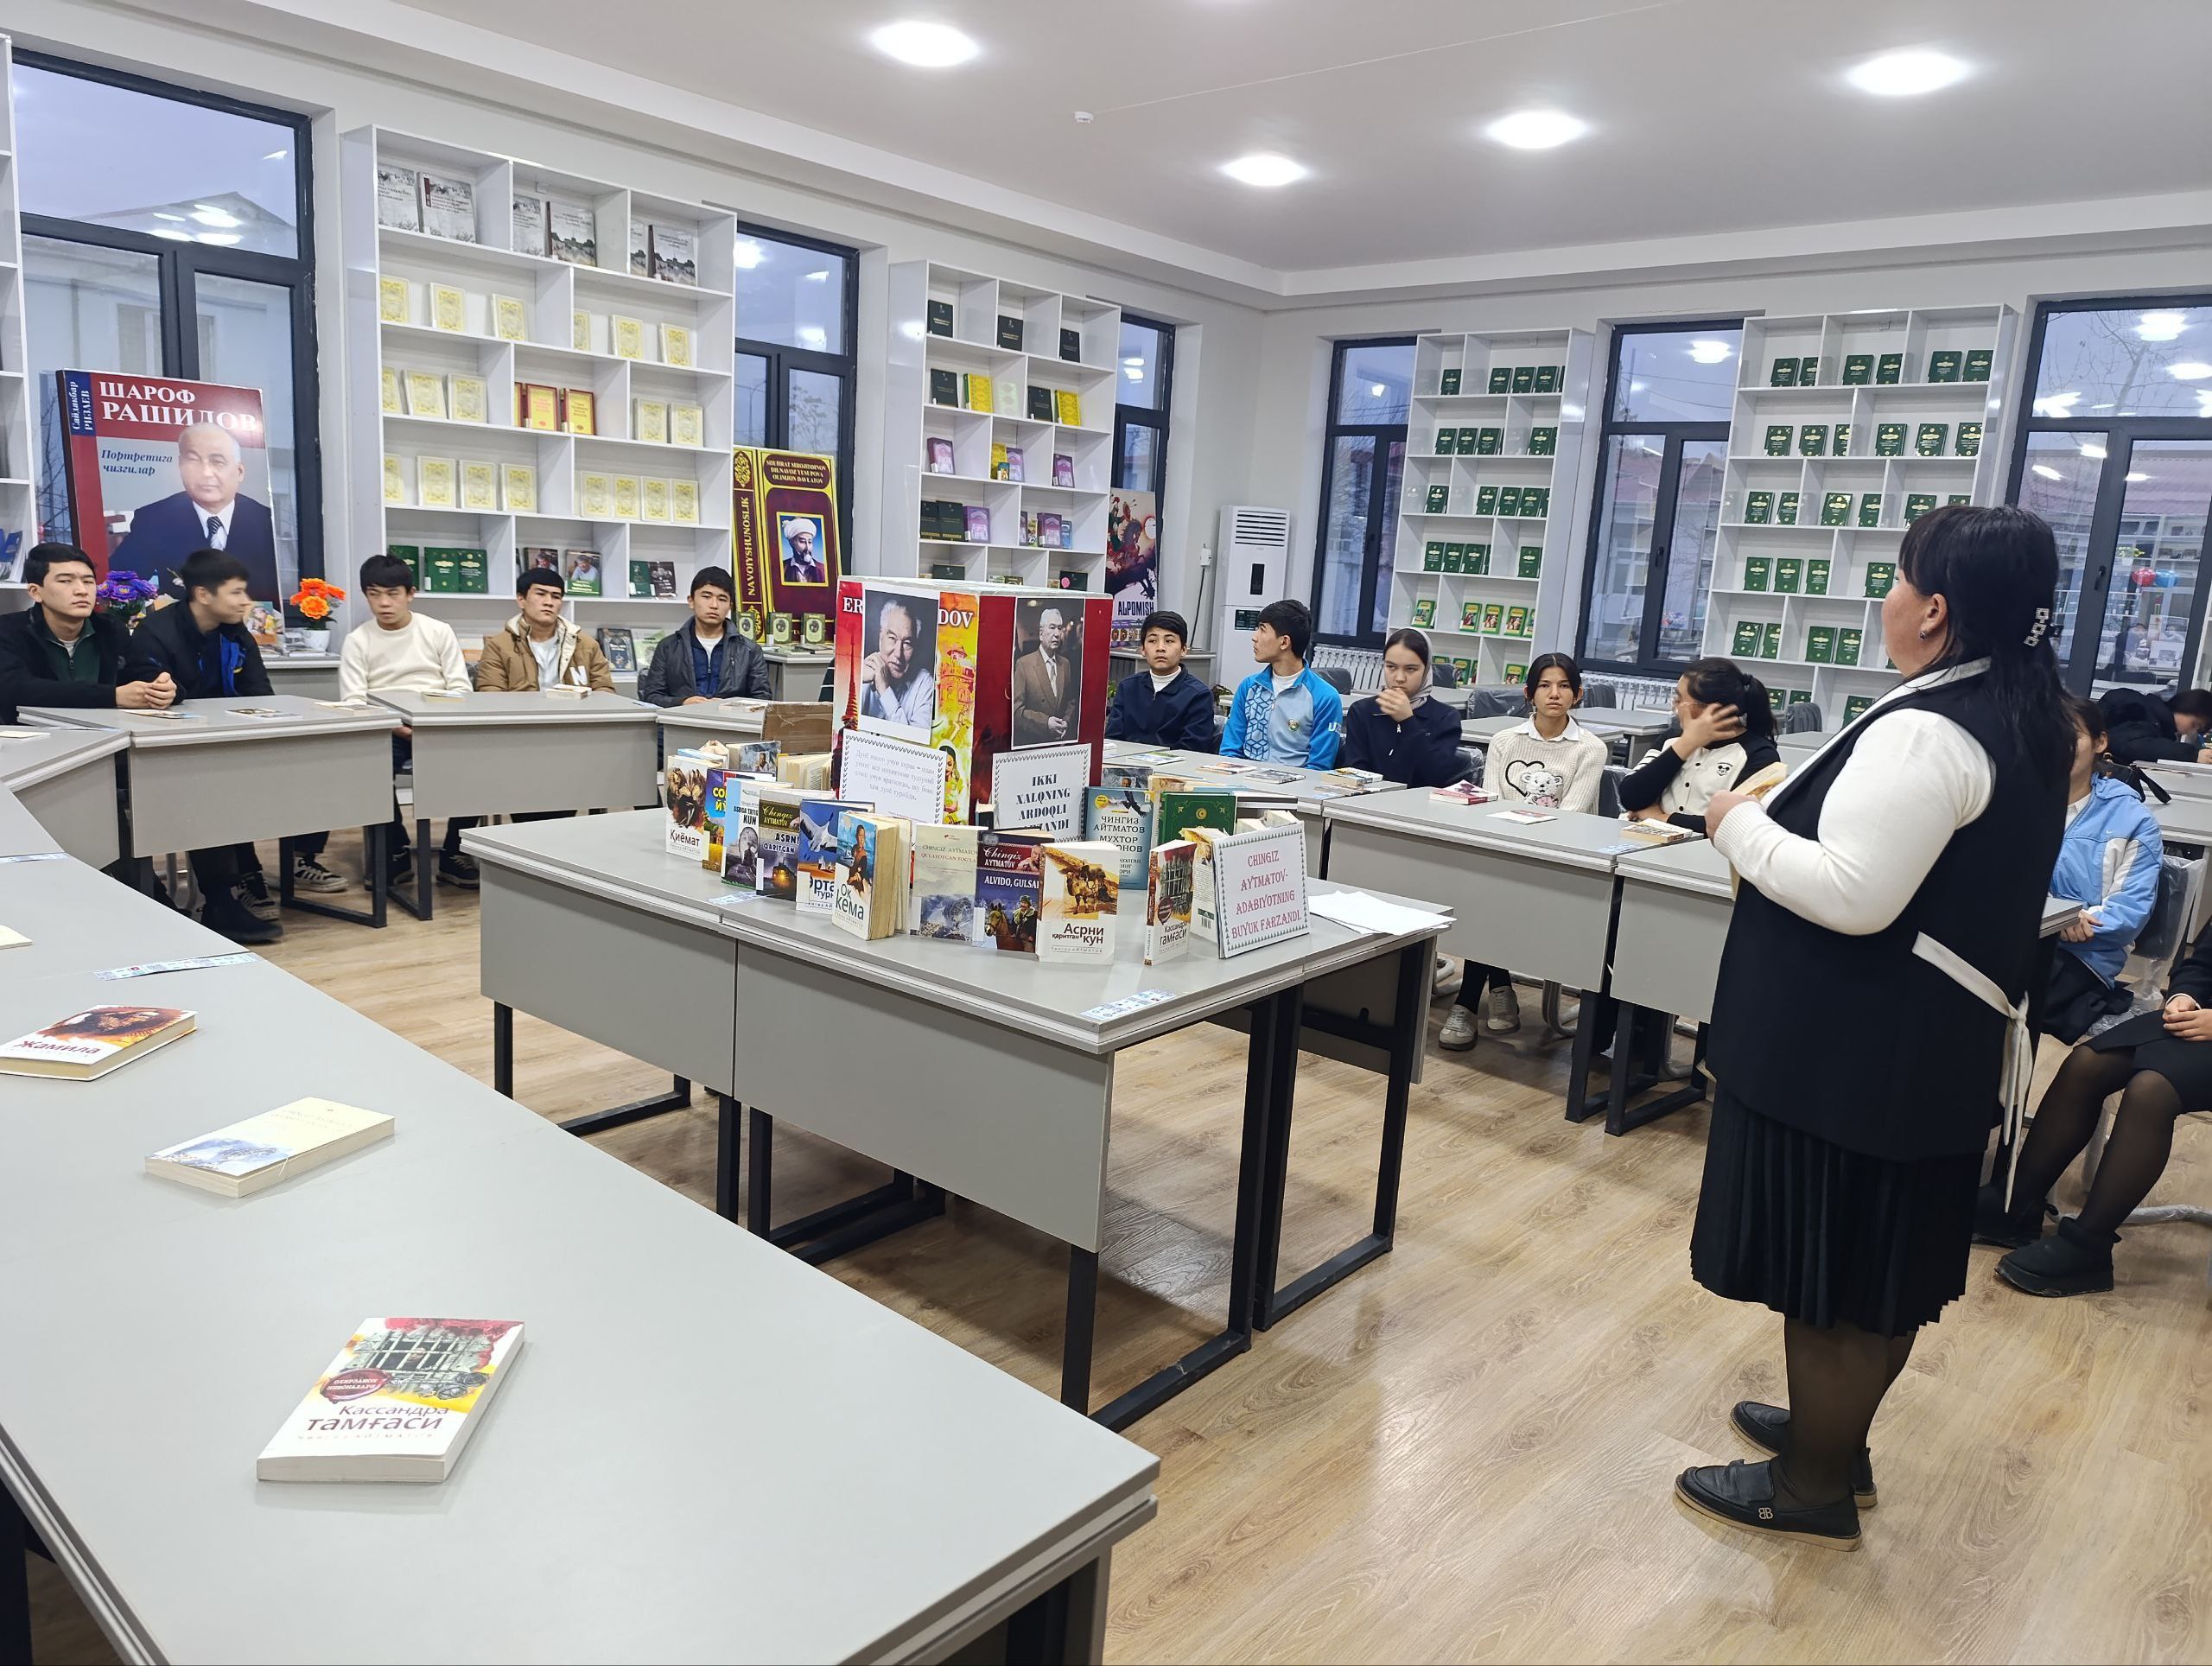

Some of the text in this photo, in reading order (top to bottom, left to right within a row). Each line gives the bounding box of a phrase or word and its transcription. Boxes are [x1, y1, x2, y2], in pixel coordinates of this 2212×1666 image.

[99, 381, 195, 404] ШАРОФ
[102, 401, 257, 432] РАШИДОВ
[101, 449, 173, 463] Портретига
[103, 464, 156, 476] чизгилар
[741, 497, 756, 596] NAVOIYSHUNOSLIK
[842, 597, 974, 628] ER DOV
[1118, 601, 1154, 616] ALPOMISH
[1032, 774, 1057, 786] IKKI
[1016, 788, 1071, 804] XALQNING
[762, 804, 793, 820] Chingiz
[1019, 804, 1066, 821] ARDOQLI
[743, 815, 757, 825] KUN
[1101, 816, 1139, 824] ЧИНГИЗ
[1093, 823, 1146, 834] АЙТМАТОВ
[671, 829, 700, 847] Қиёмат
[775, 833, 799, 844] ASRNI
[1099, 835, 1138, 843] МУХТОР
[763, 843, 795, 854] QARITGAN
[983, 847, 1021, 862] Chingiz
[984, 859, 1015, 868] AYTMATOV
[1248, 850, 1280, 867] CHINGIZ
[984, 875, 1013, 887] ALVIDO,
[1241, 868, 1288, 891] AYTMATOV-
[836, 888, 865, 921] кема
[1236, 890, 1295, 915] ADABIYOTNING
[1064, 923, 1104, 938] Асрни
[1231, 910, 1302, 939] BUYUK FARZANDI.
[1083, 936, 1103, 946] кун
[14, 1040, 101, 1054] Жамила
[339, 1405, 449, 1417] Кассандра
[307, 1417, 443, 1431] тамғаси
